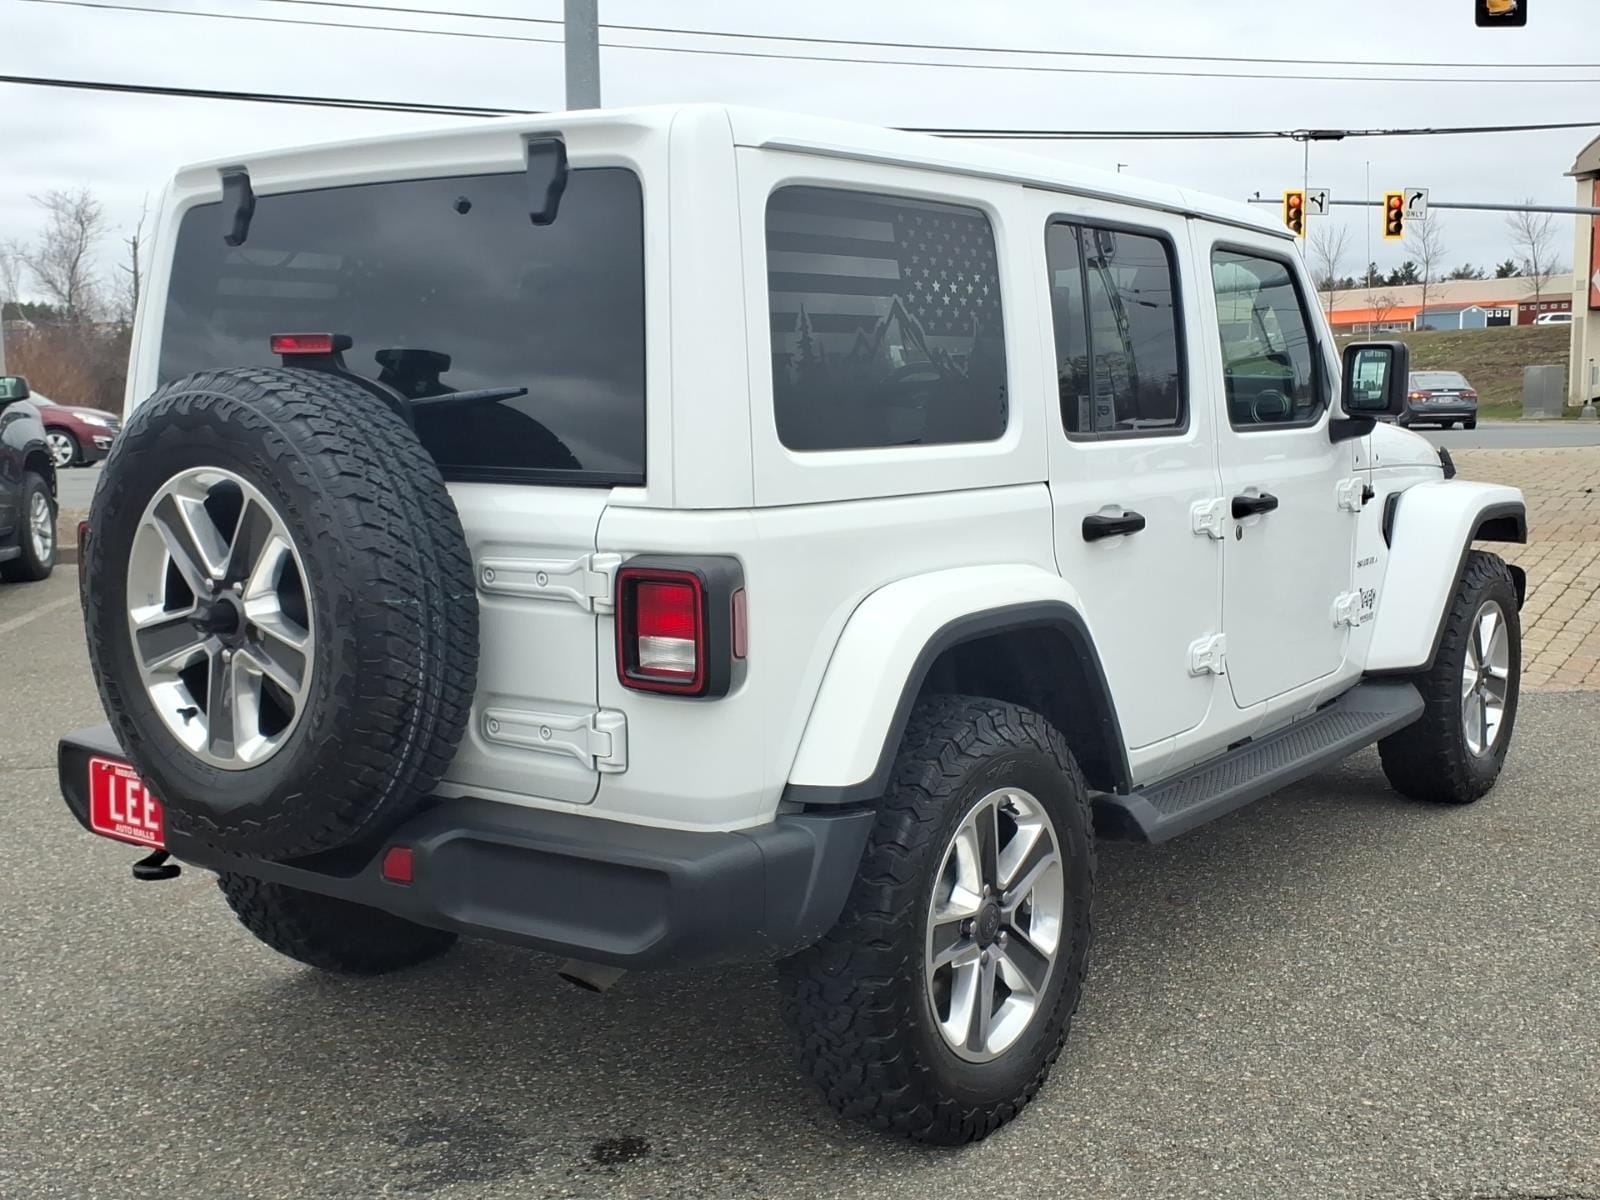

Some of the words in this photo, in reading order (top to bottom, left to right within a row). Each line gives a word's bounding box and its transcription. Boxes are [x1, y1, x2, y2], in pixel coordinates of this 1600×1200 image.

[1406, 210, 1424, 218] ONLY
[109, 774, 159, 830] LEE
[115, 823, 133, 836] AUTO
[133, 828, 155, 841] MALLS
